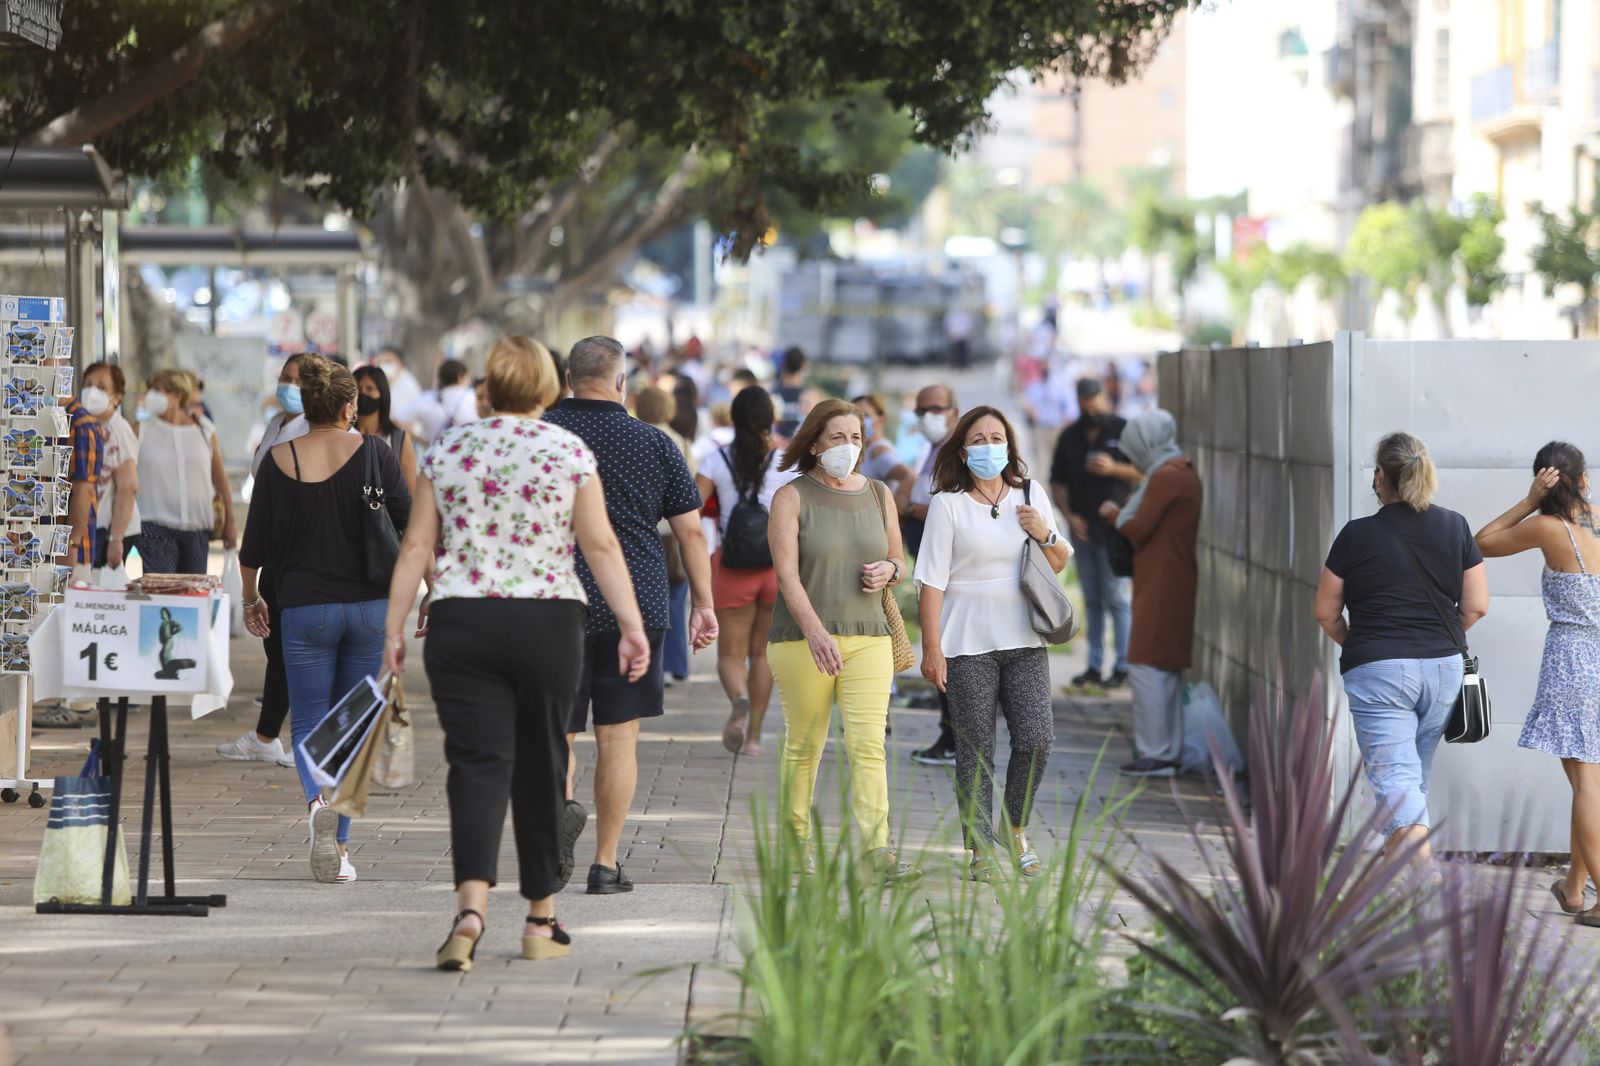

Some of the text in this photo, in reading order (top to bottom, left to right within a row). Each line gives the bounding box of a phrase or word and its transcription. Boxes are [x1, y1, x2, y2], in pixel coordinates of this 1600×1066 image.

[74, 602, 126, 611] ALMENDRAS
[94, 613, 106, 621] DE
[72, 621, 128, 636] MÁLAGA
